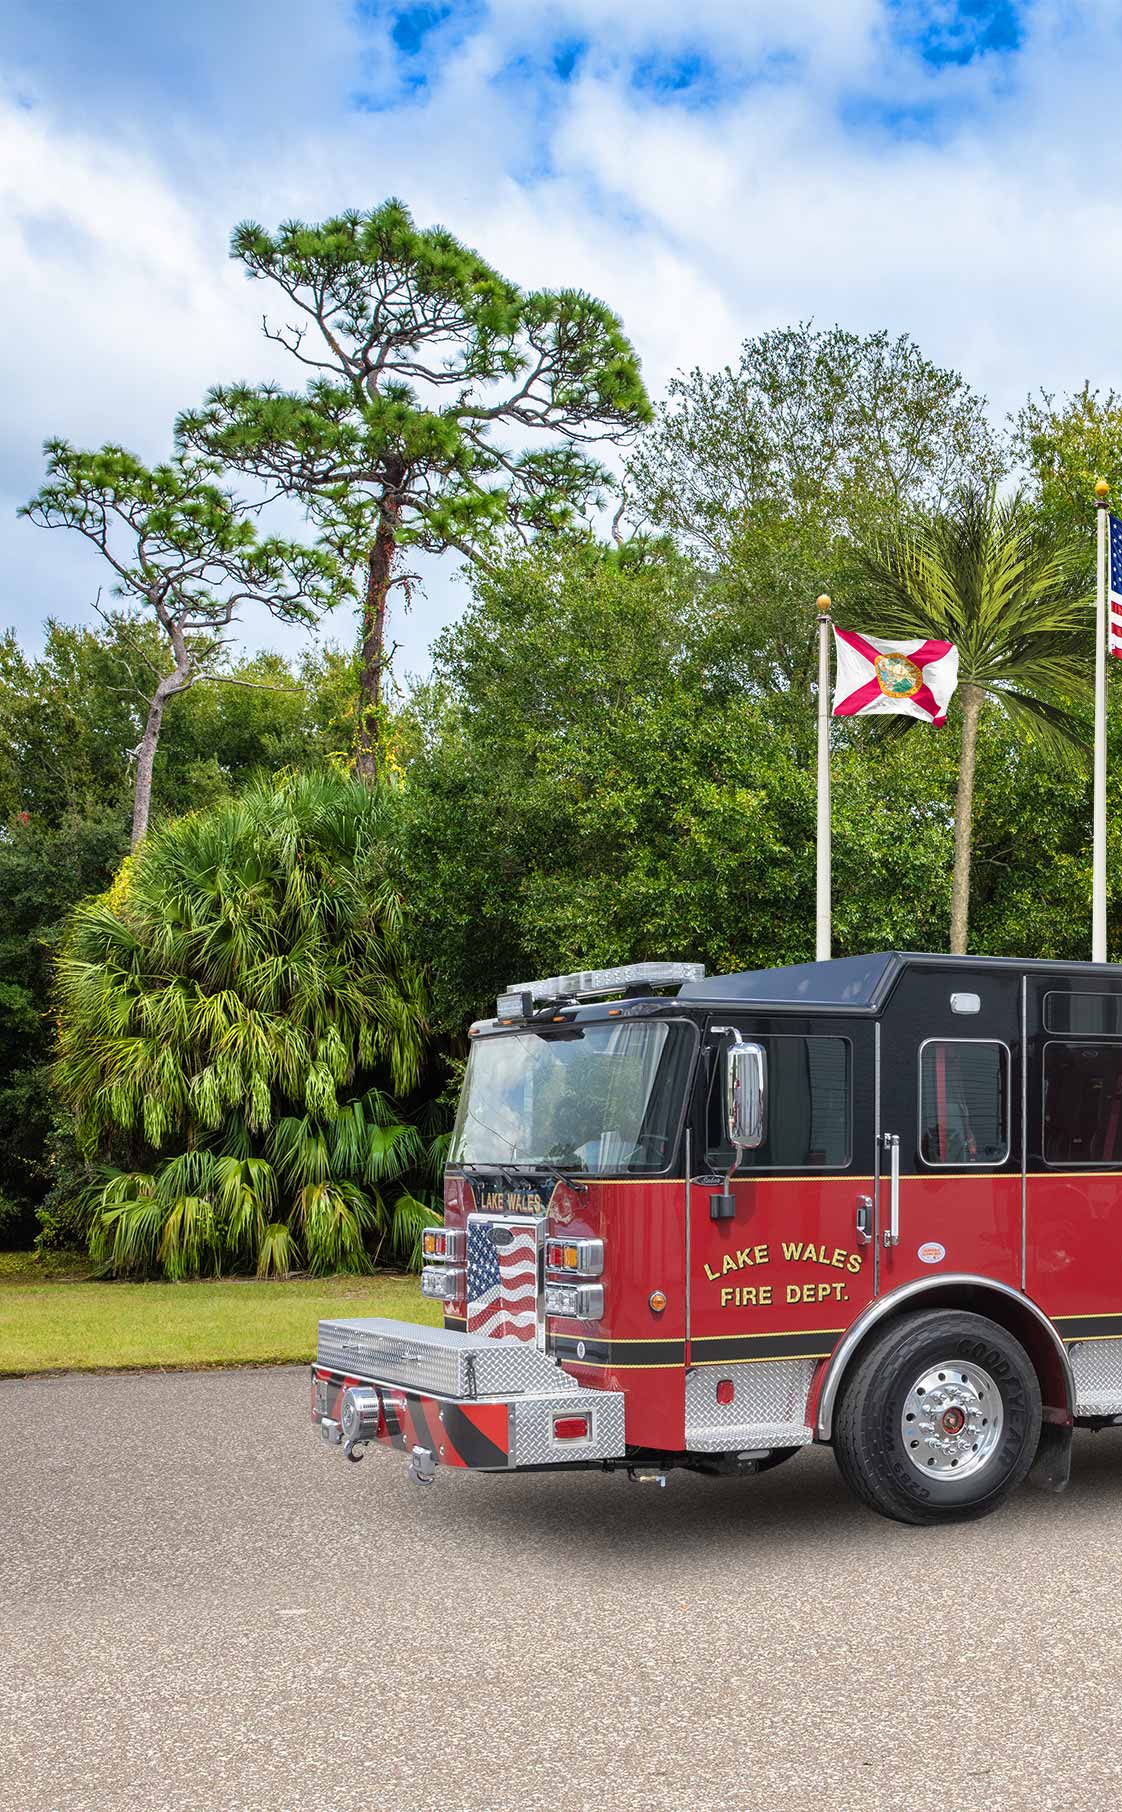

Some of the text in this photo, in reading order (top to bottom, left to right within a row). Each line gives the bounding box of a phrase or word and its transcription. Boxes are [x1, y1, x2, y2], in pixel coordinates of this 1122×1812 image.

[481, 1192, 542, 1213] LAKE WALES
[703, 1242, 863, 1281] LAKE WALES
[720, 1282, 849, 1307] FIRE DEPT.
